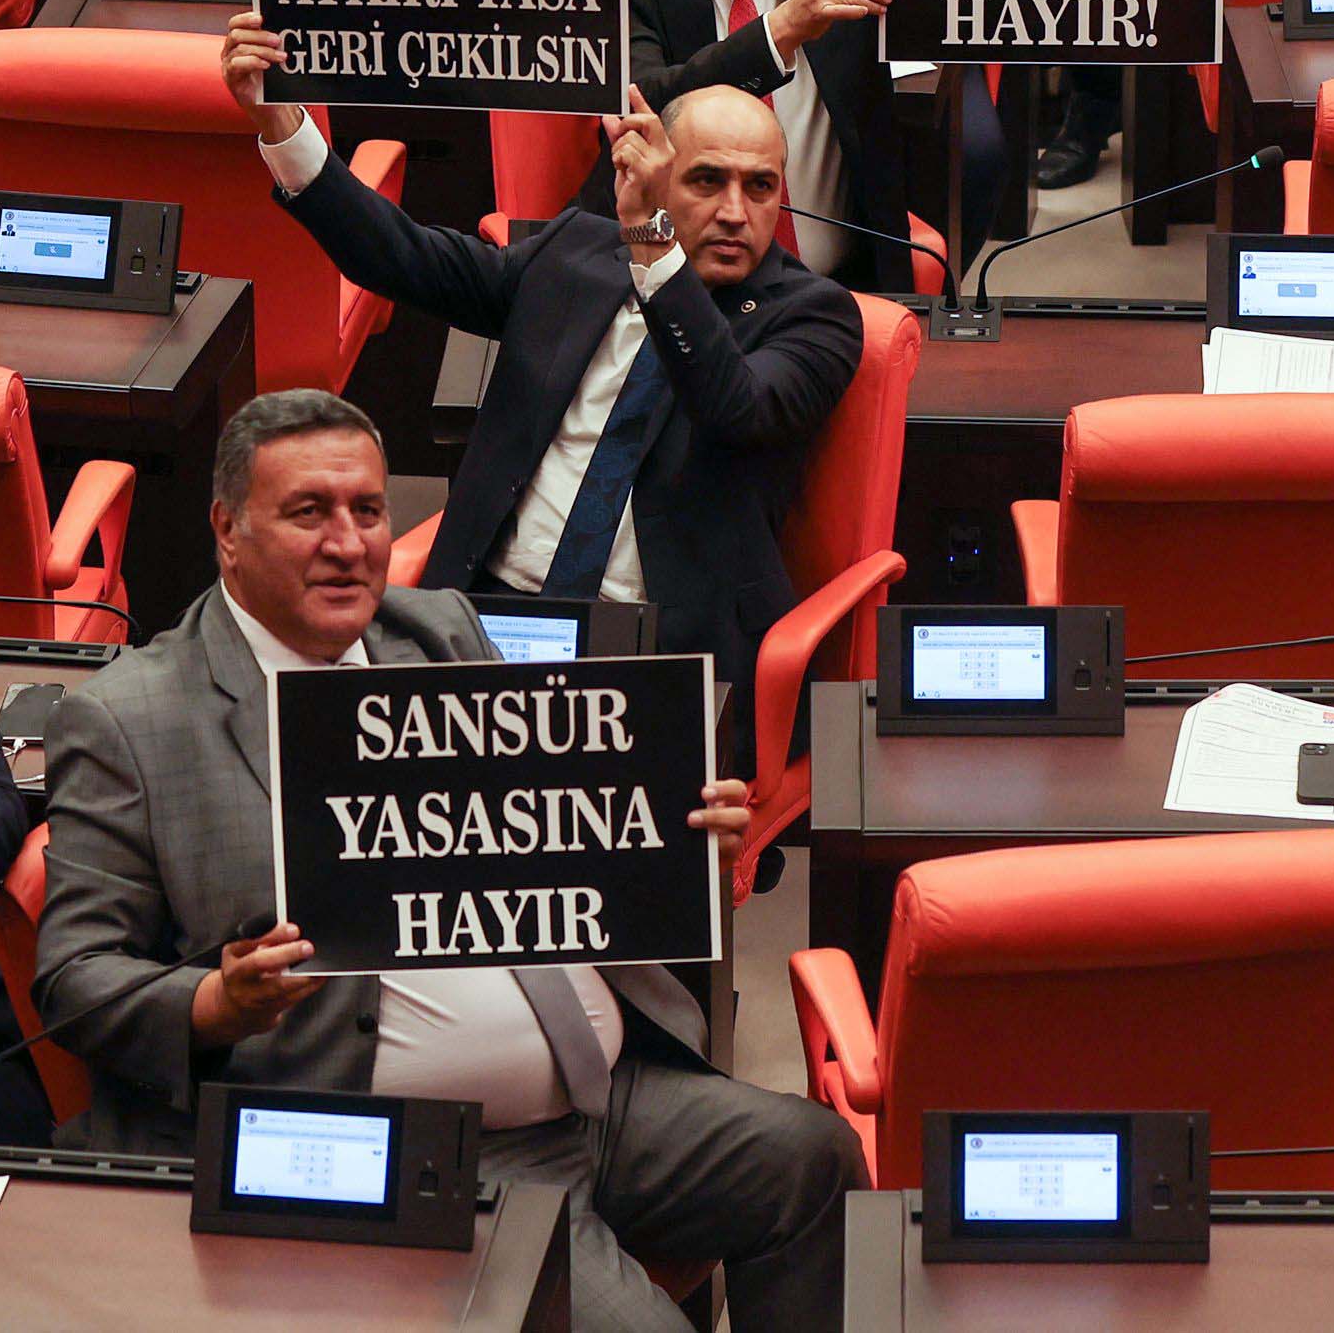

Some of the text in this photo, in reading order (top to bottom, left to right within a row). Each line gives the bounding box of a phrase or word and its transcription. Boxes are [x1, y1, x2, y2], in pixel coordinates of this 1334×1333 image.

[279, 20, 609, 89] GERİ ÇEKİLSİN
[356, 674, 634, 760] SANSÜR
[326, 786, 665, 860] YASASINA
[392, 887, 609, 958] HAYIR
